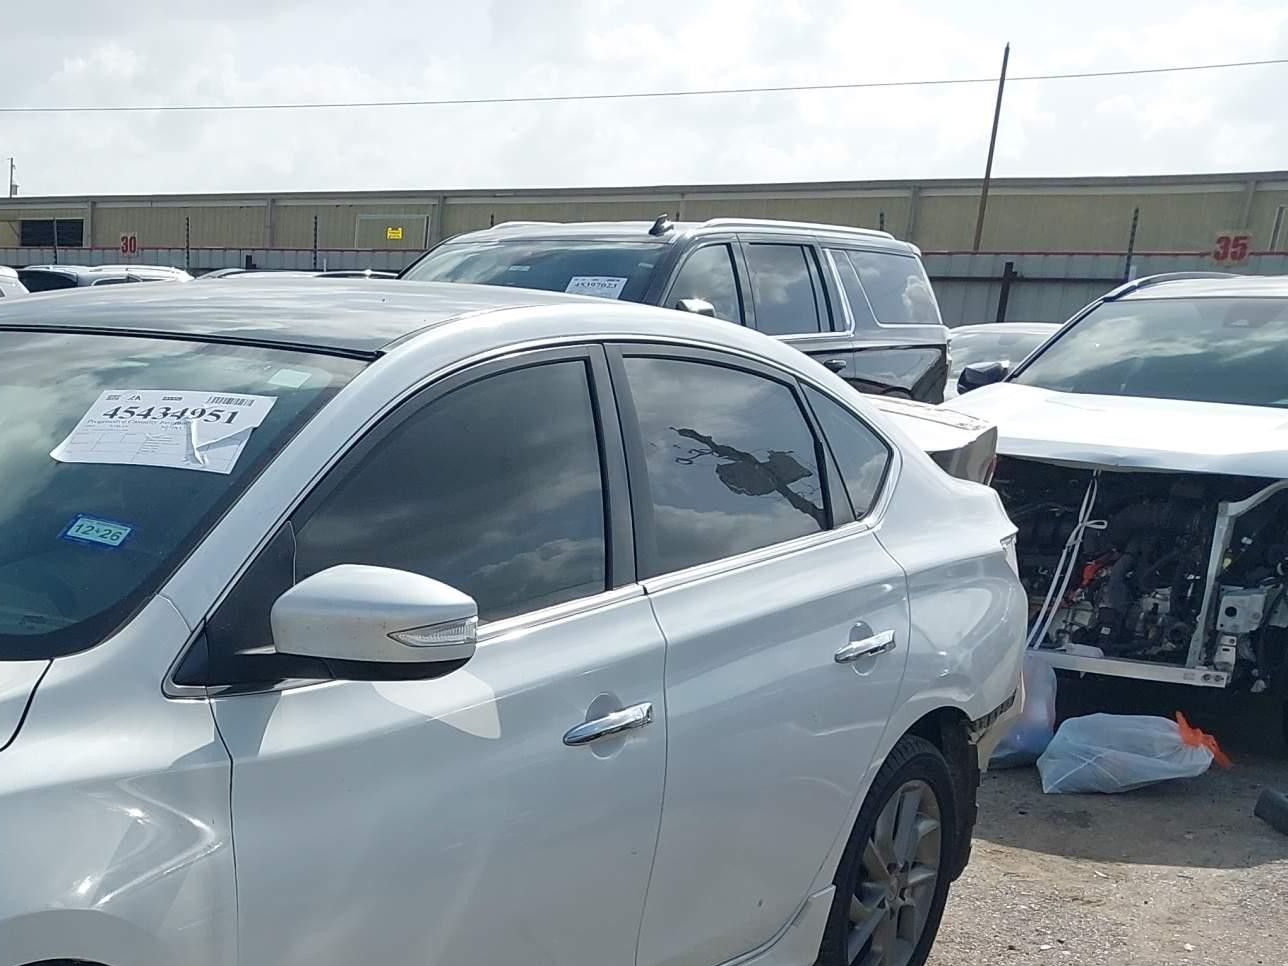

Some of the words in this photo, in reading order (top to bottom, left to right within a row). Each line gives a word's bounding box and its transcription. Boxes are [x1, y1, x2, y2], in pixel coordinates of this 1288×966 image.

[120, 236, 137, 253] 30
[1214, 236, 1248, 261] 35
[102, 405, 239, 424] 45434951
